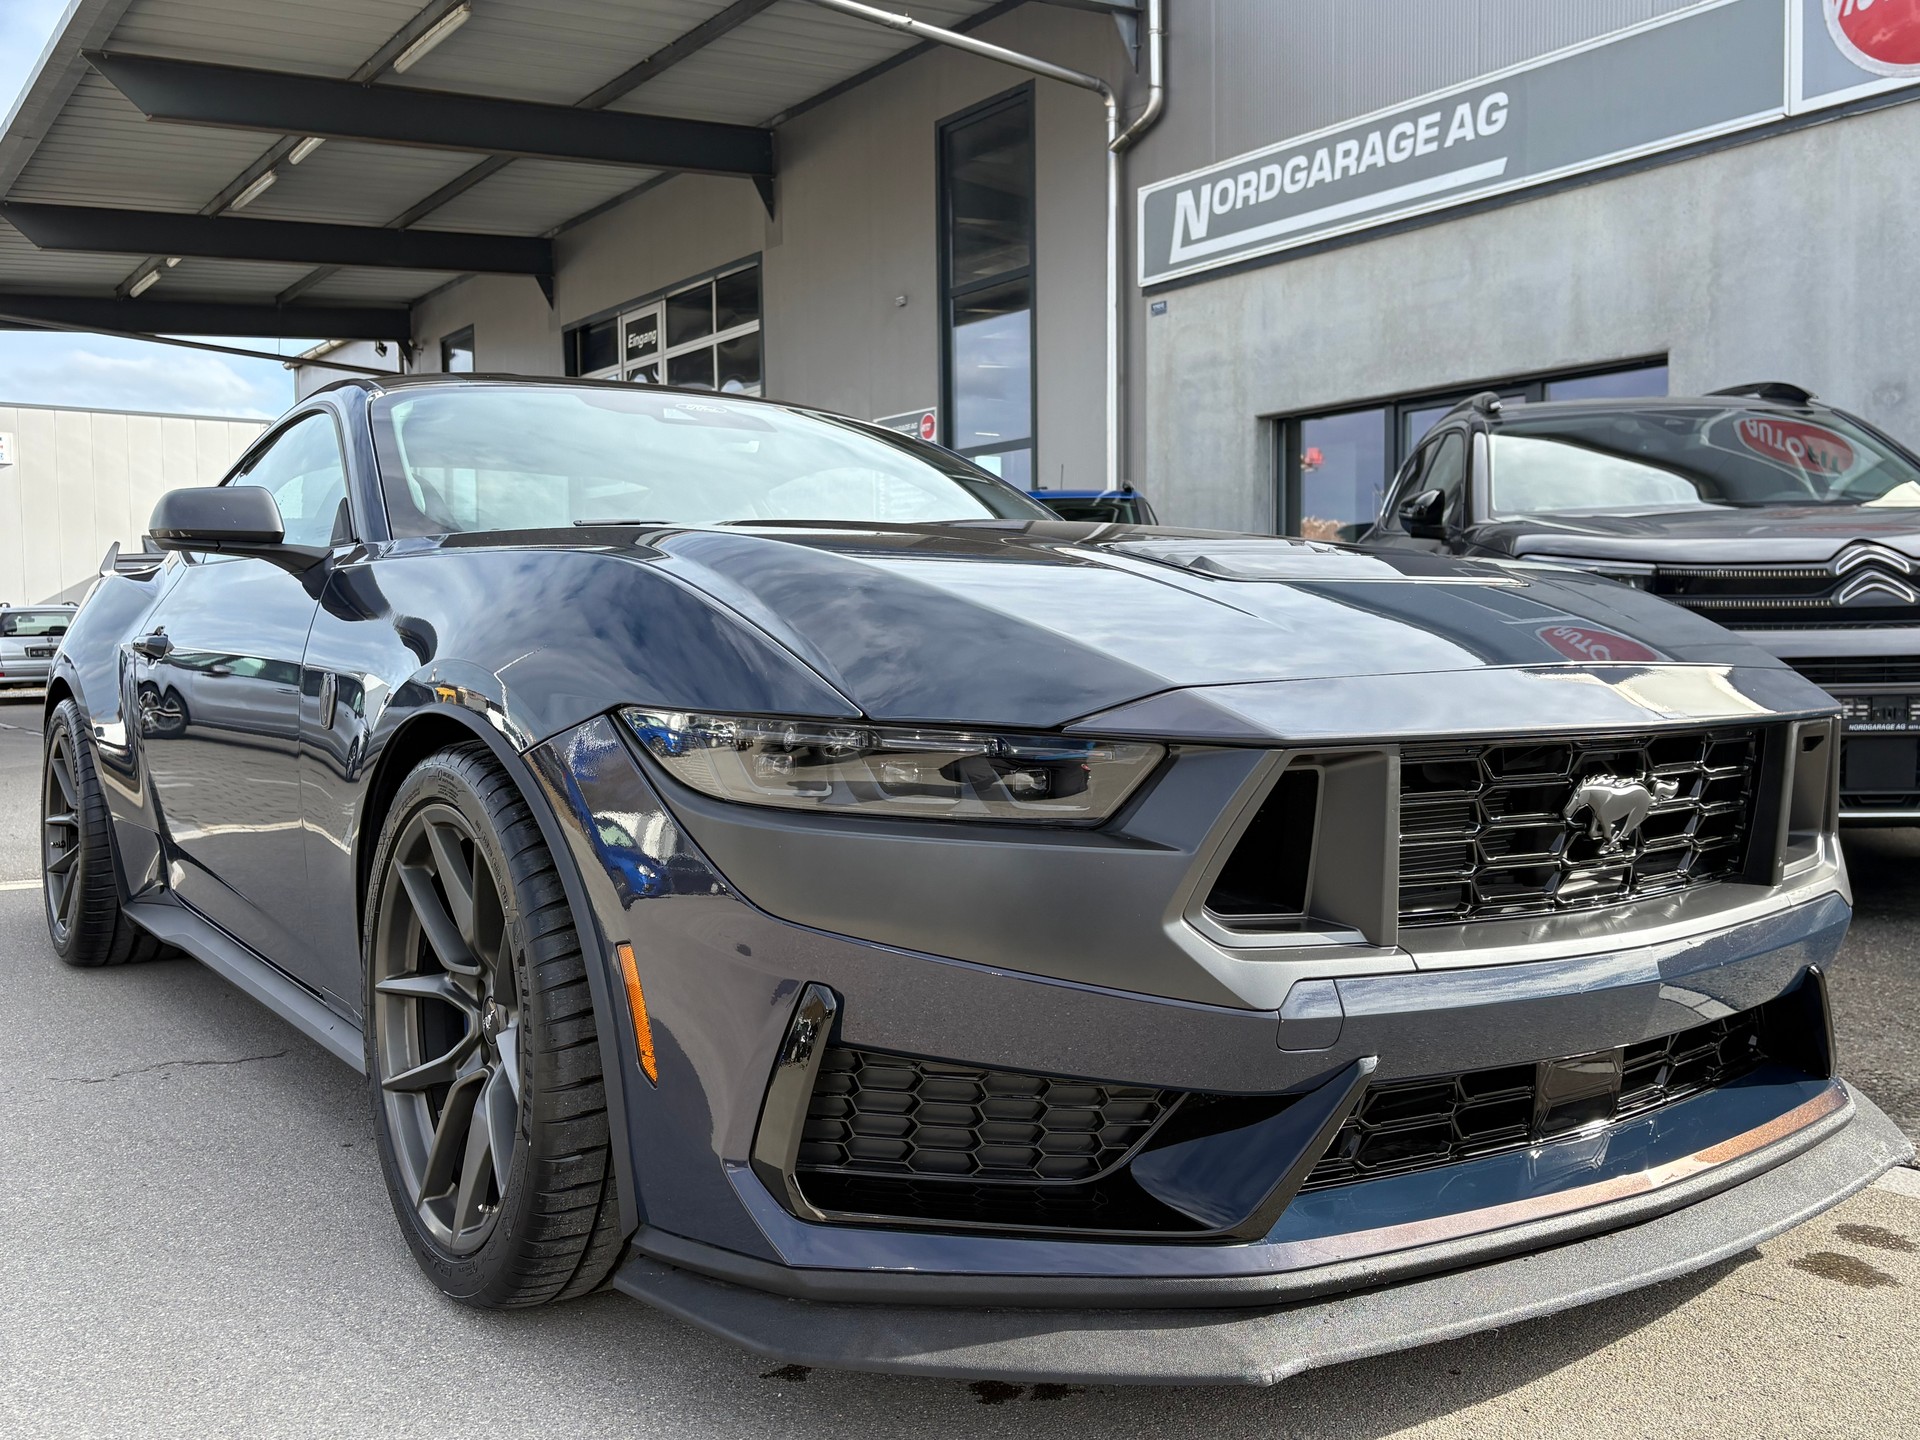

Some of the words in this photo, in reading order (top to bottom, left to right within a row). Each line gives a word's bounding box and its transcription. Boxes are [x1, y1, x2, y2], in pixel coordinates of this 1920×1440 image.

[1170, 111, 1441, 264] NORDGARAGE
[1444, 92, 1508, 147] AG
[627, 330, 657, 348] Eingang
[1848, 723, 1895, 731] NORDGARAGE
[1895, 723, 1906, 731] AG
